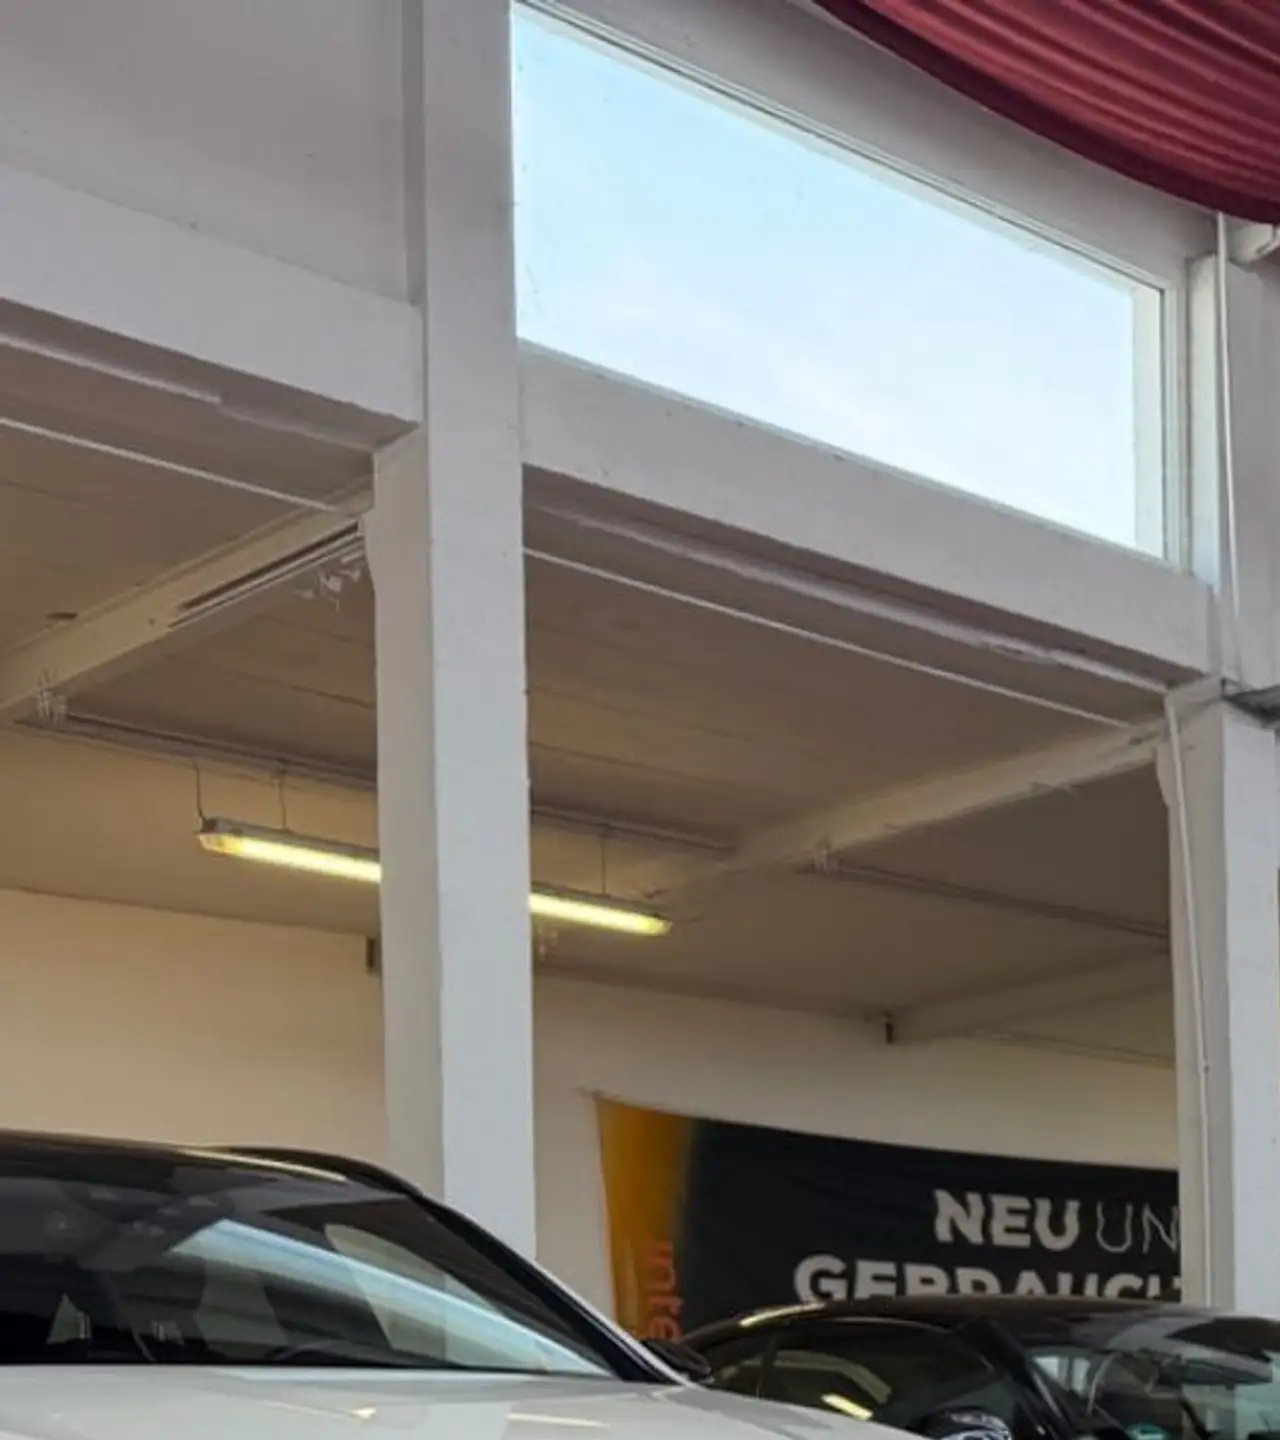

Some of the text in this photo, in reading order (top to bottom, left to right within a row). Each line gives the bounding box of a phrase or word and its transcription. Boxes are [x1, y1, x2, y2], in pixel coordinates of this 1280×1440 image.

[933, 1189, 1180, 1255] NEU UN
[644, 1240, 685, 1345] inte
